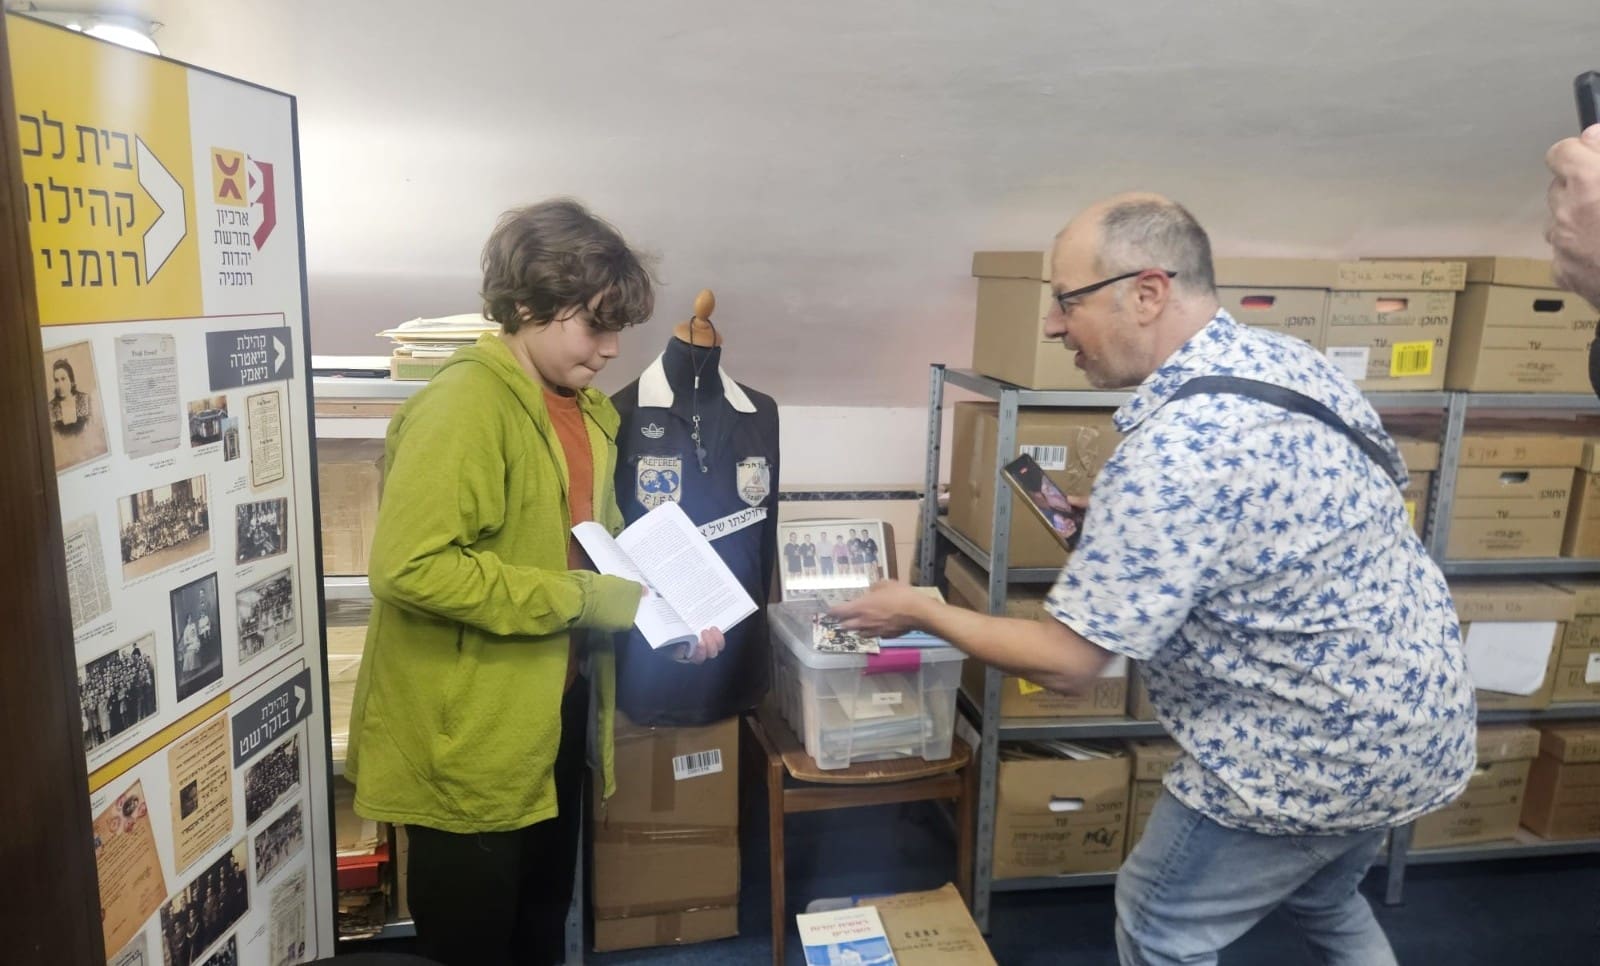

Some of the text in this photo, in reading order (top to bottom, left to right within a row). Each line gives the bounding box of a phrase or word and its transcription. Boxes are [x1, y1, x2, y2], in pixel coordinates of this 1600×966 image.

[75, 124, 133, 170] בית
[216, 209, 249, 227] ארכיון
[214, 229, 250, 246] מורשת
[222, 251, 251, 266] יהדות
[218, 271, 253, 286] רומניה
[236, 334, 266, 350] קהילת
[229, 350, 267, 369] פיאטרה
[240, 366, 269, 385] ניאמץ
[642, 457, 678, 467] REFEREE
[728, 507, 763, 528] חולצתו
[709, 521, 725, 536] של
[261, 692, 289, 720] קהילת
[239, 708, 290, 757] בוקרשט
